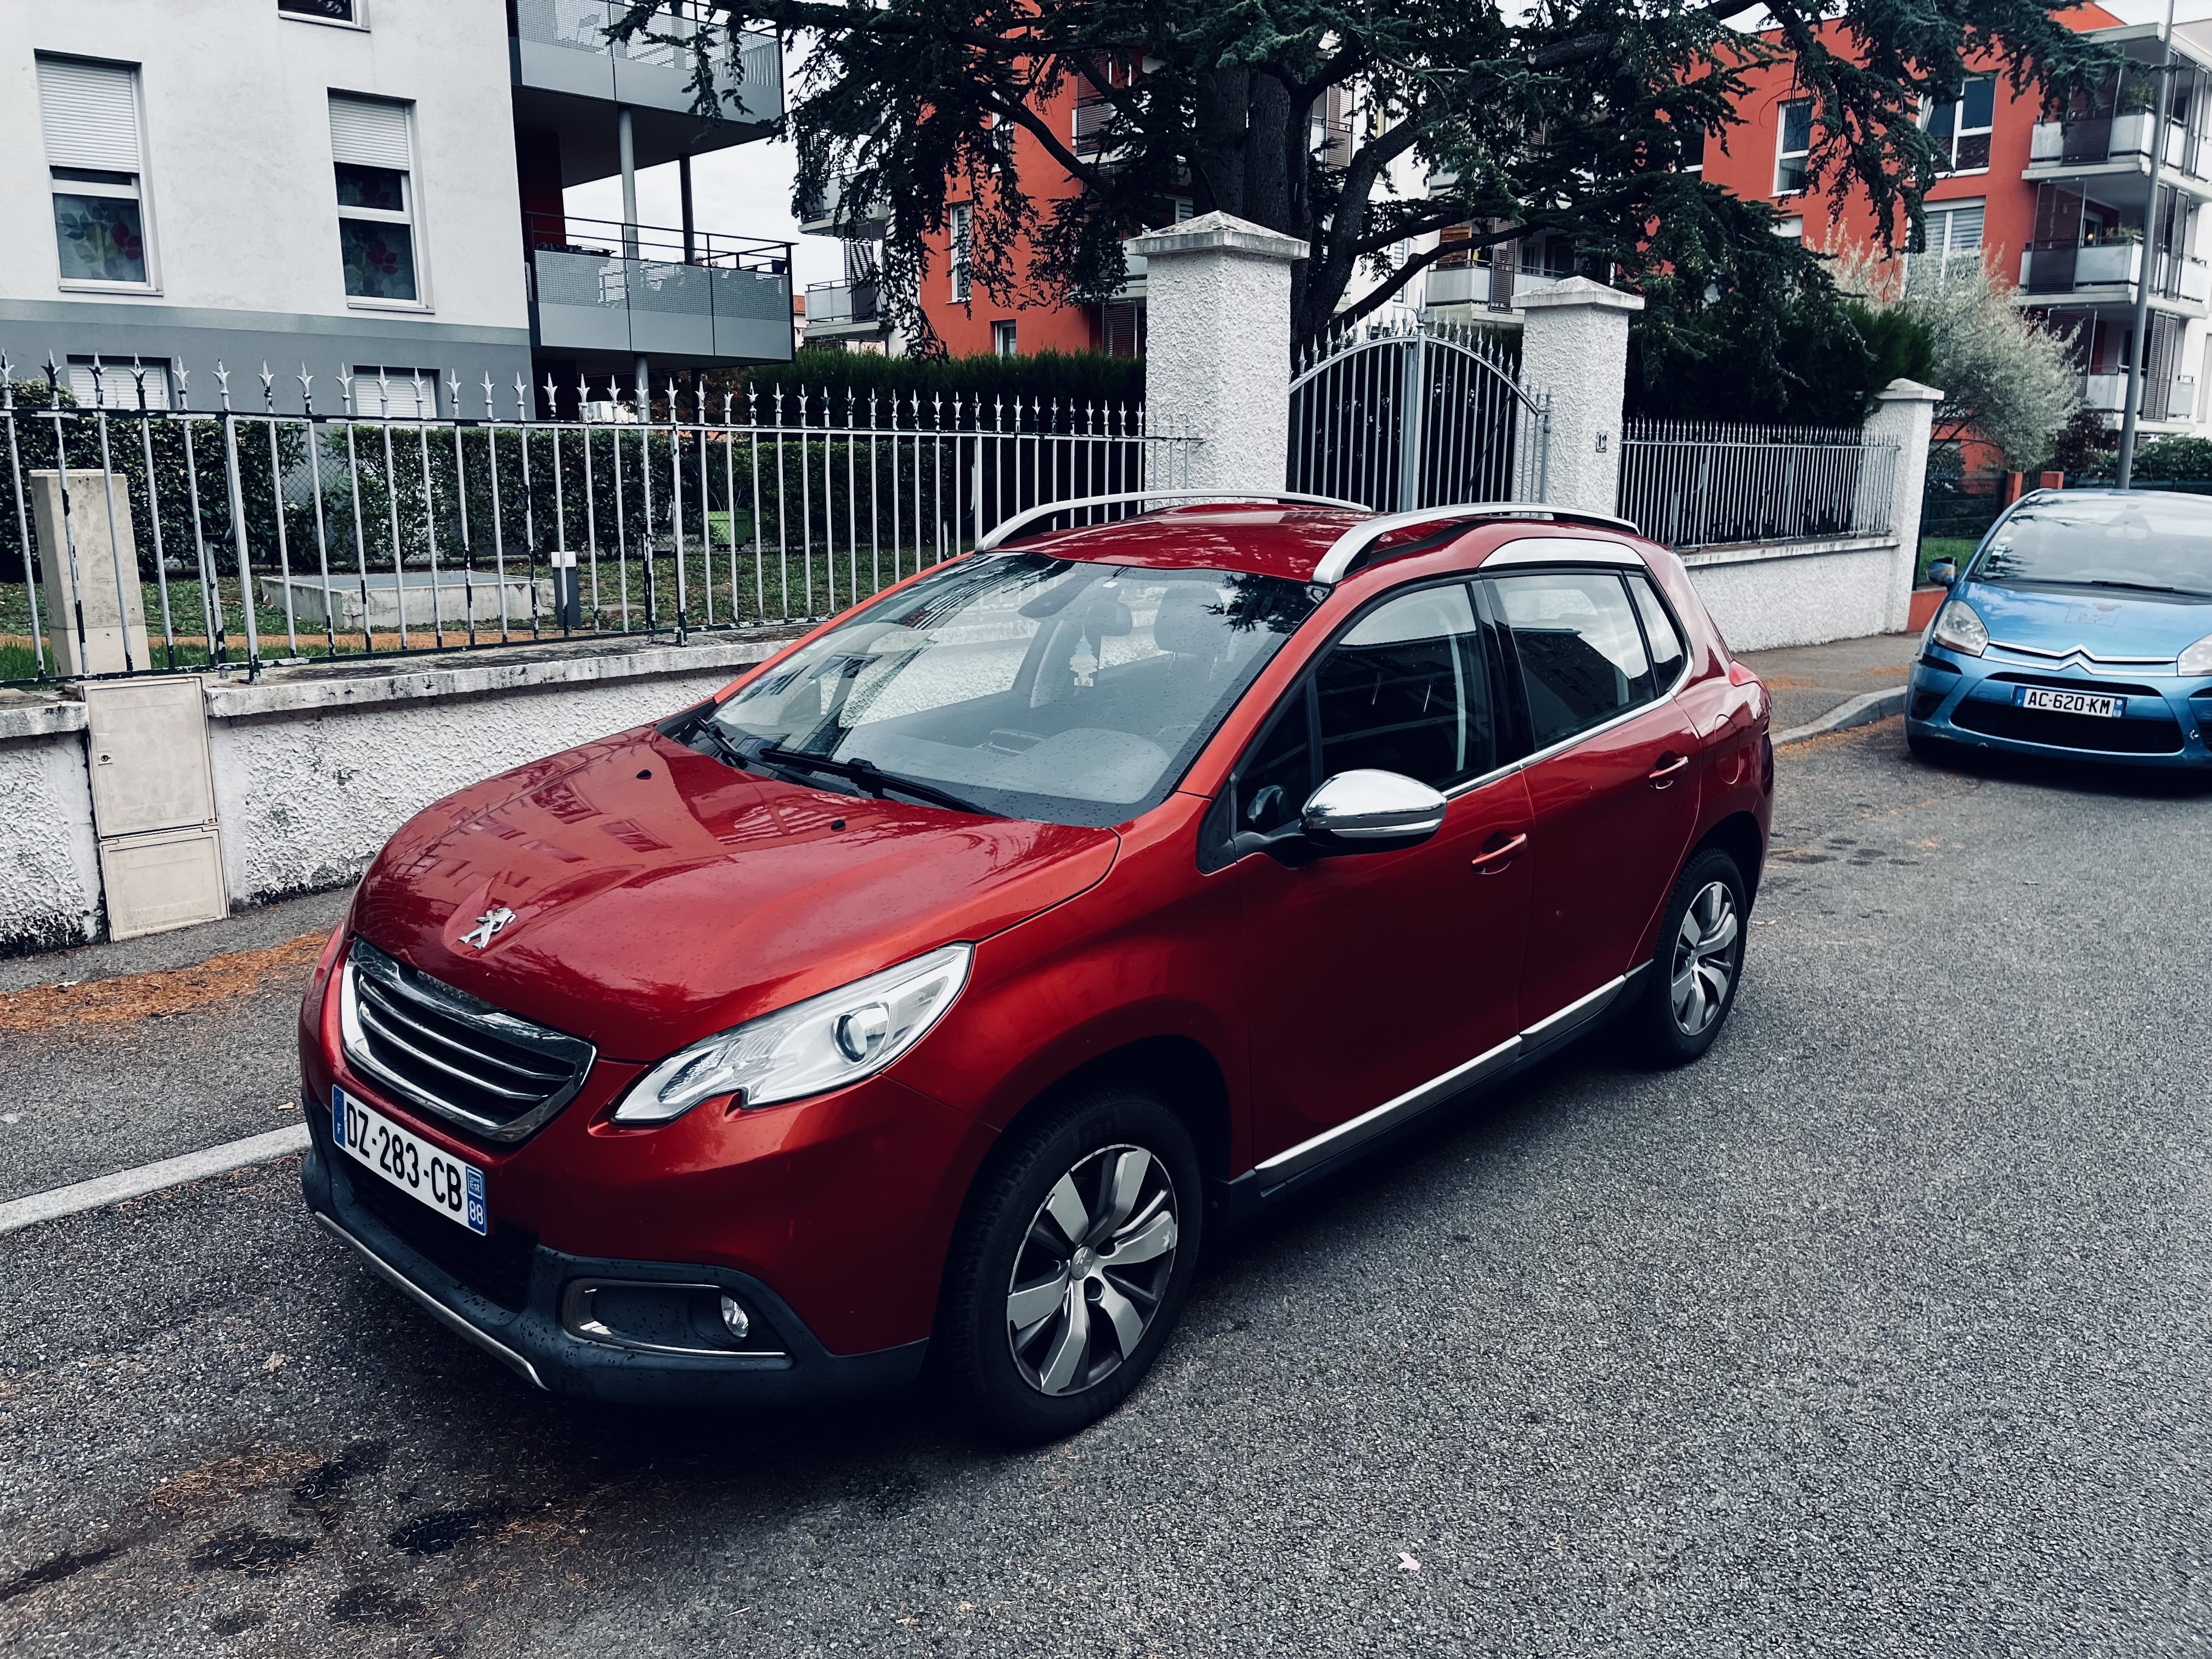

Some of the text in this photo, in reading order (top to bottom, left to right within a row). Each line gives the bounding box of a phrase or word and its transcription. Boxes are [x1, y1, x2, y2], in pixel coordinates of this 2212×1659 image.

[2027, 691, 2111, 715] AC-620-KM
[337, 1122, 341, 1135] F
[346, 1101, 462, 1212] DZ-283-CB
[470, 1180, 480, 1193] Est
[469, 1200, 484, 1225] 88
